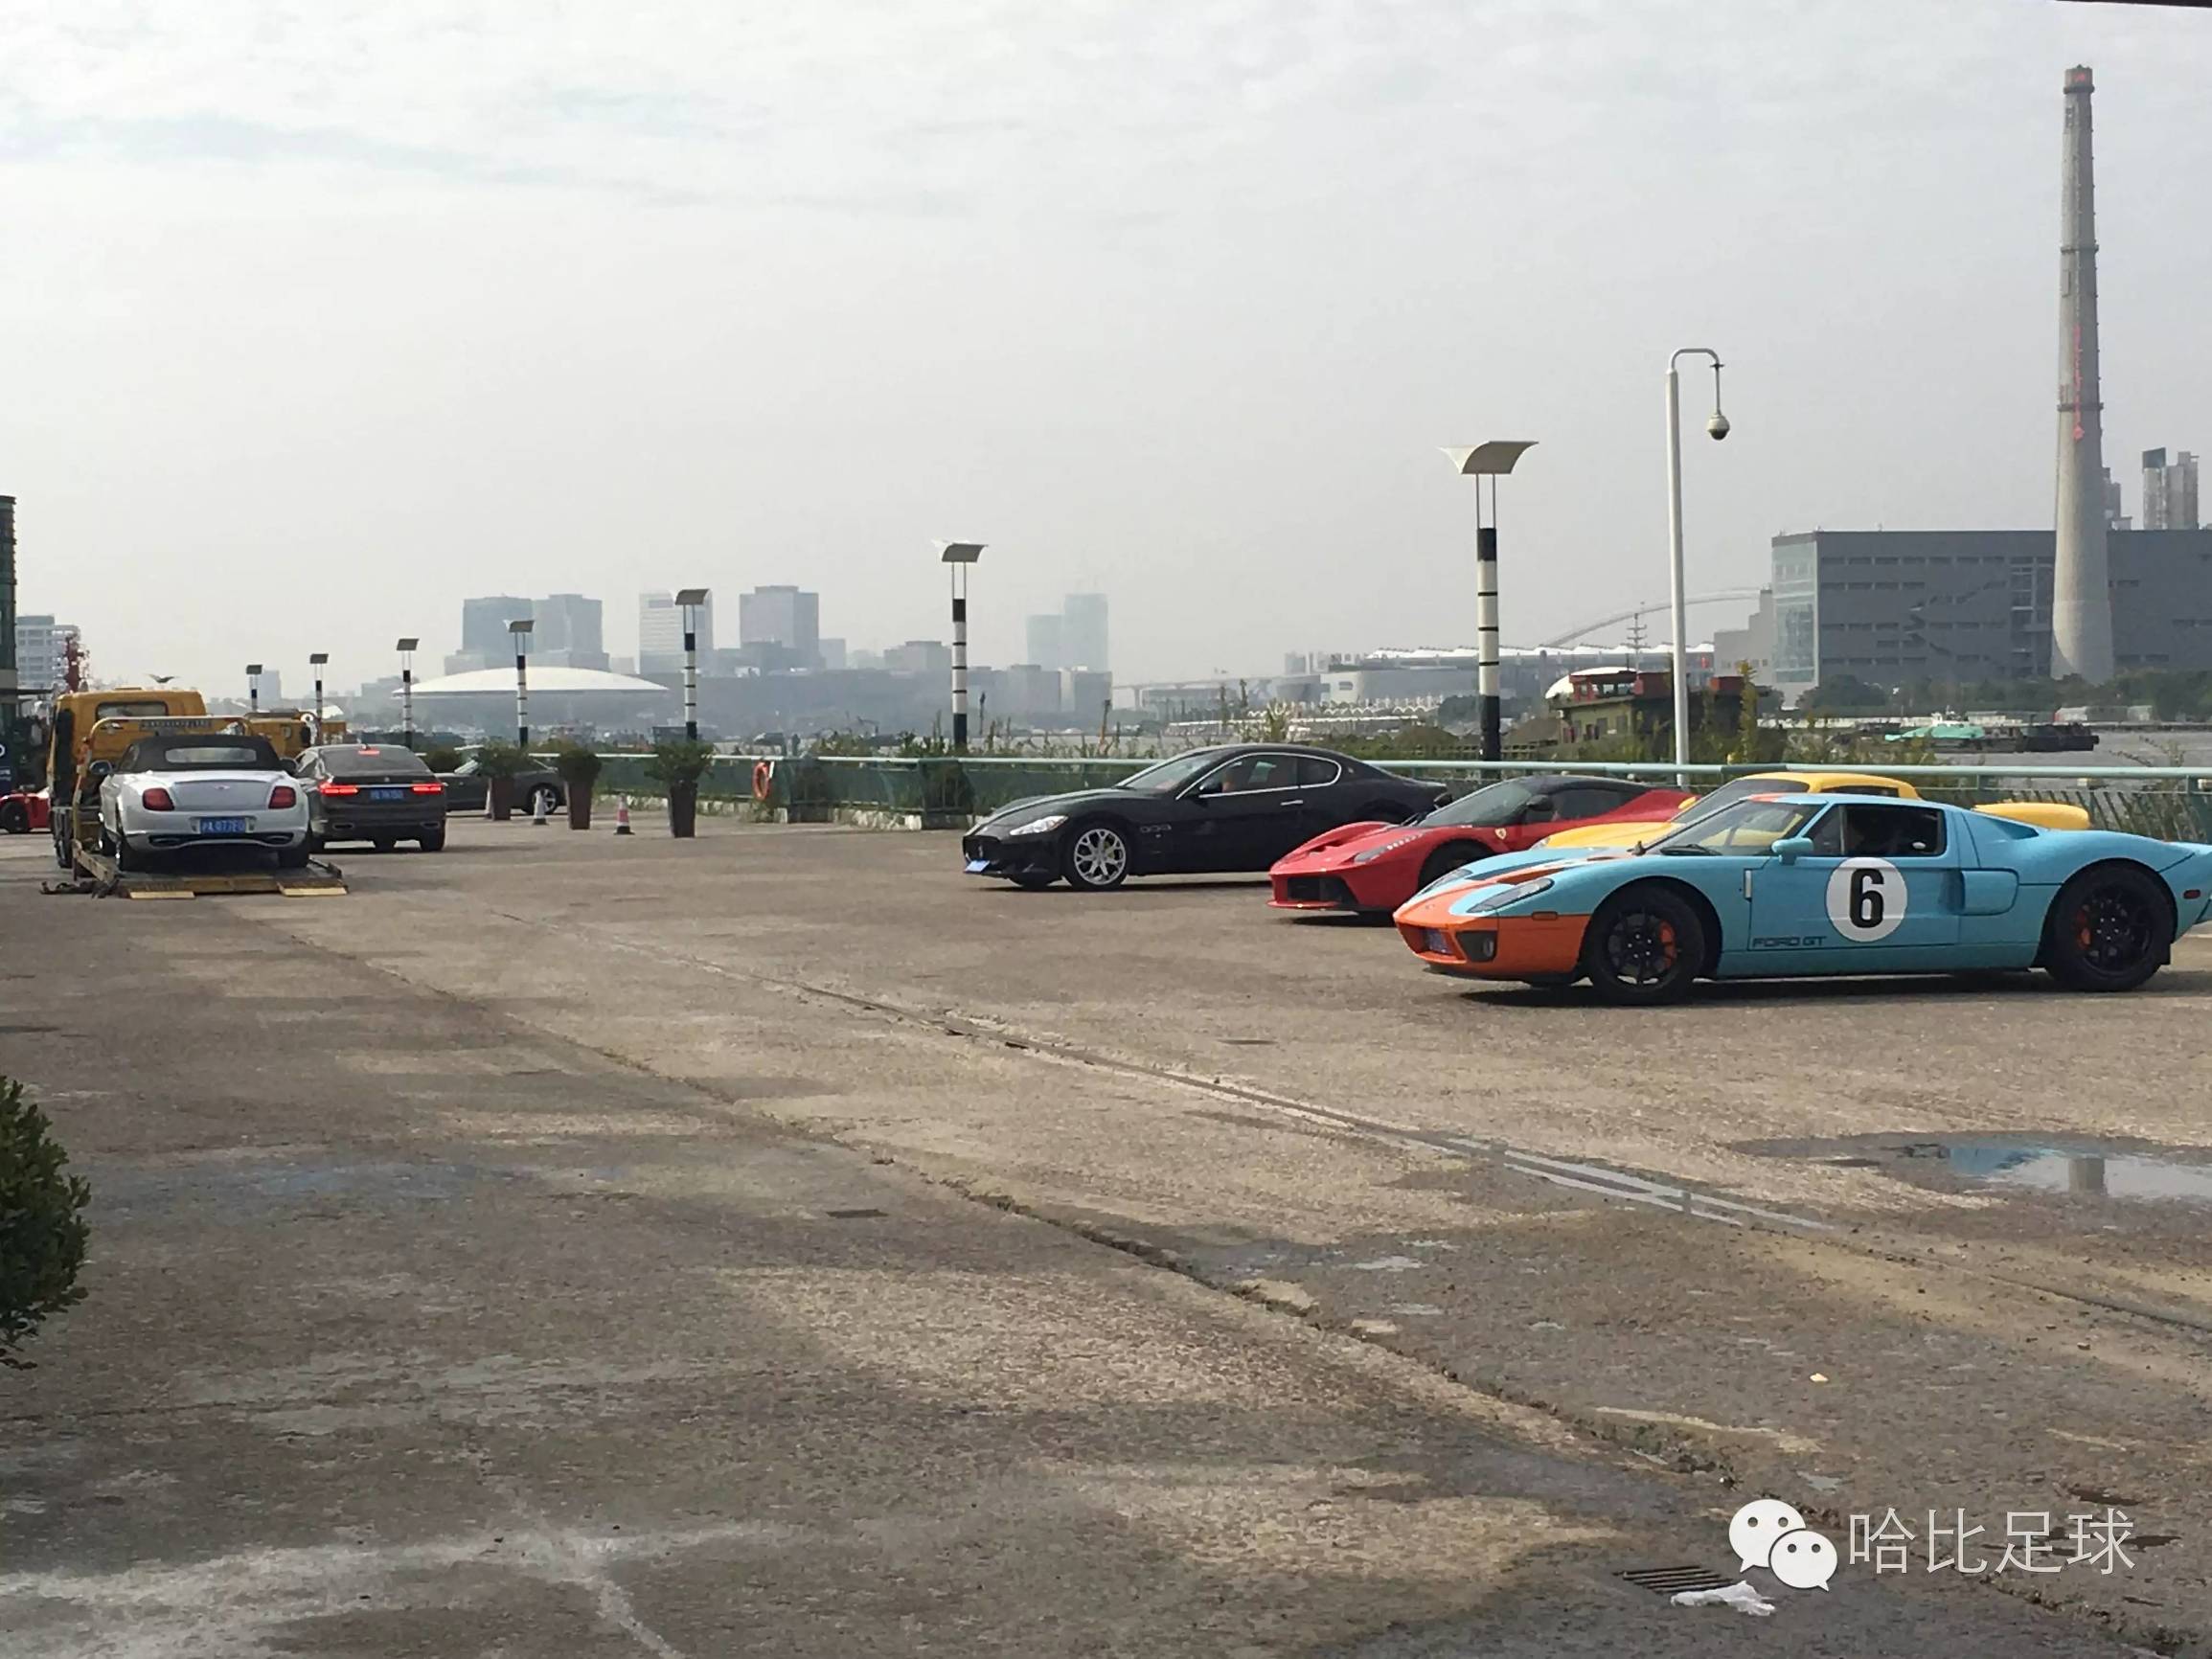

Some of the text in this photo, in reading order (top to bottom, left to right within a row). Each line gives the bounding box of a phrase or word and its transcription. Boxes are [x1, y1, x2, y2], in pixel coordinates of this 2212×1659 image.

[1849, 868, 1884, 928] 6
[1752, 936, 1828, 947] FORD GT
